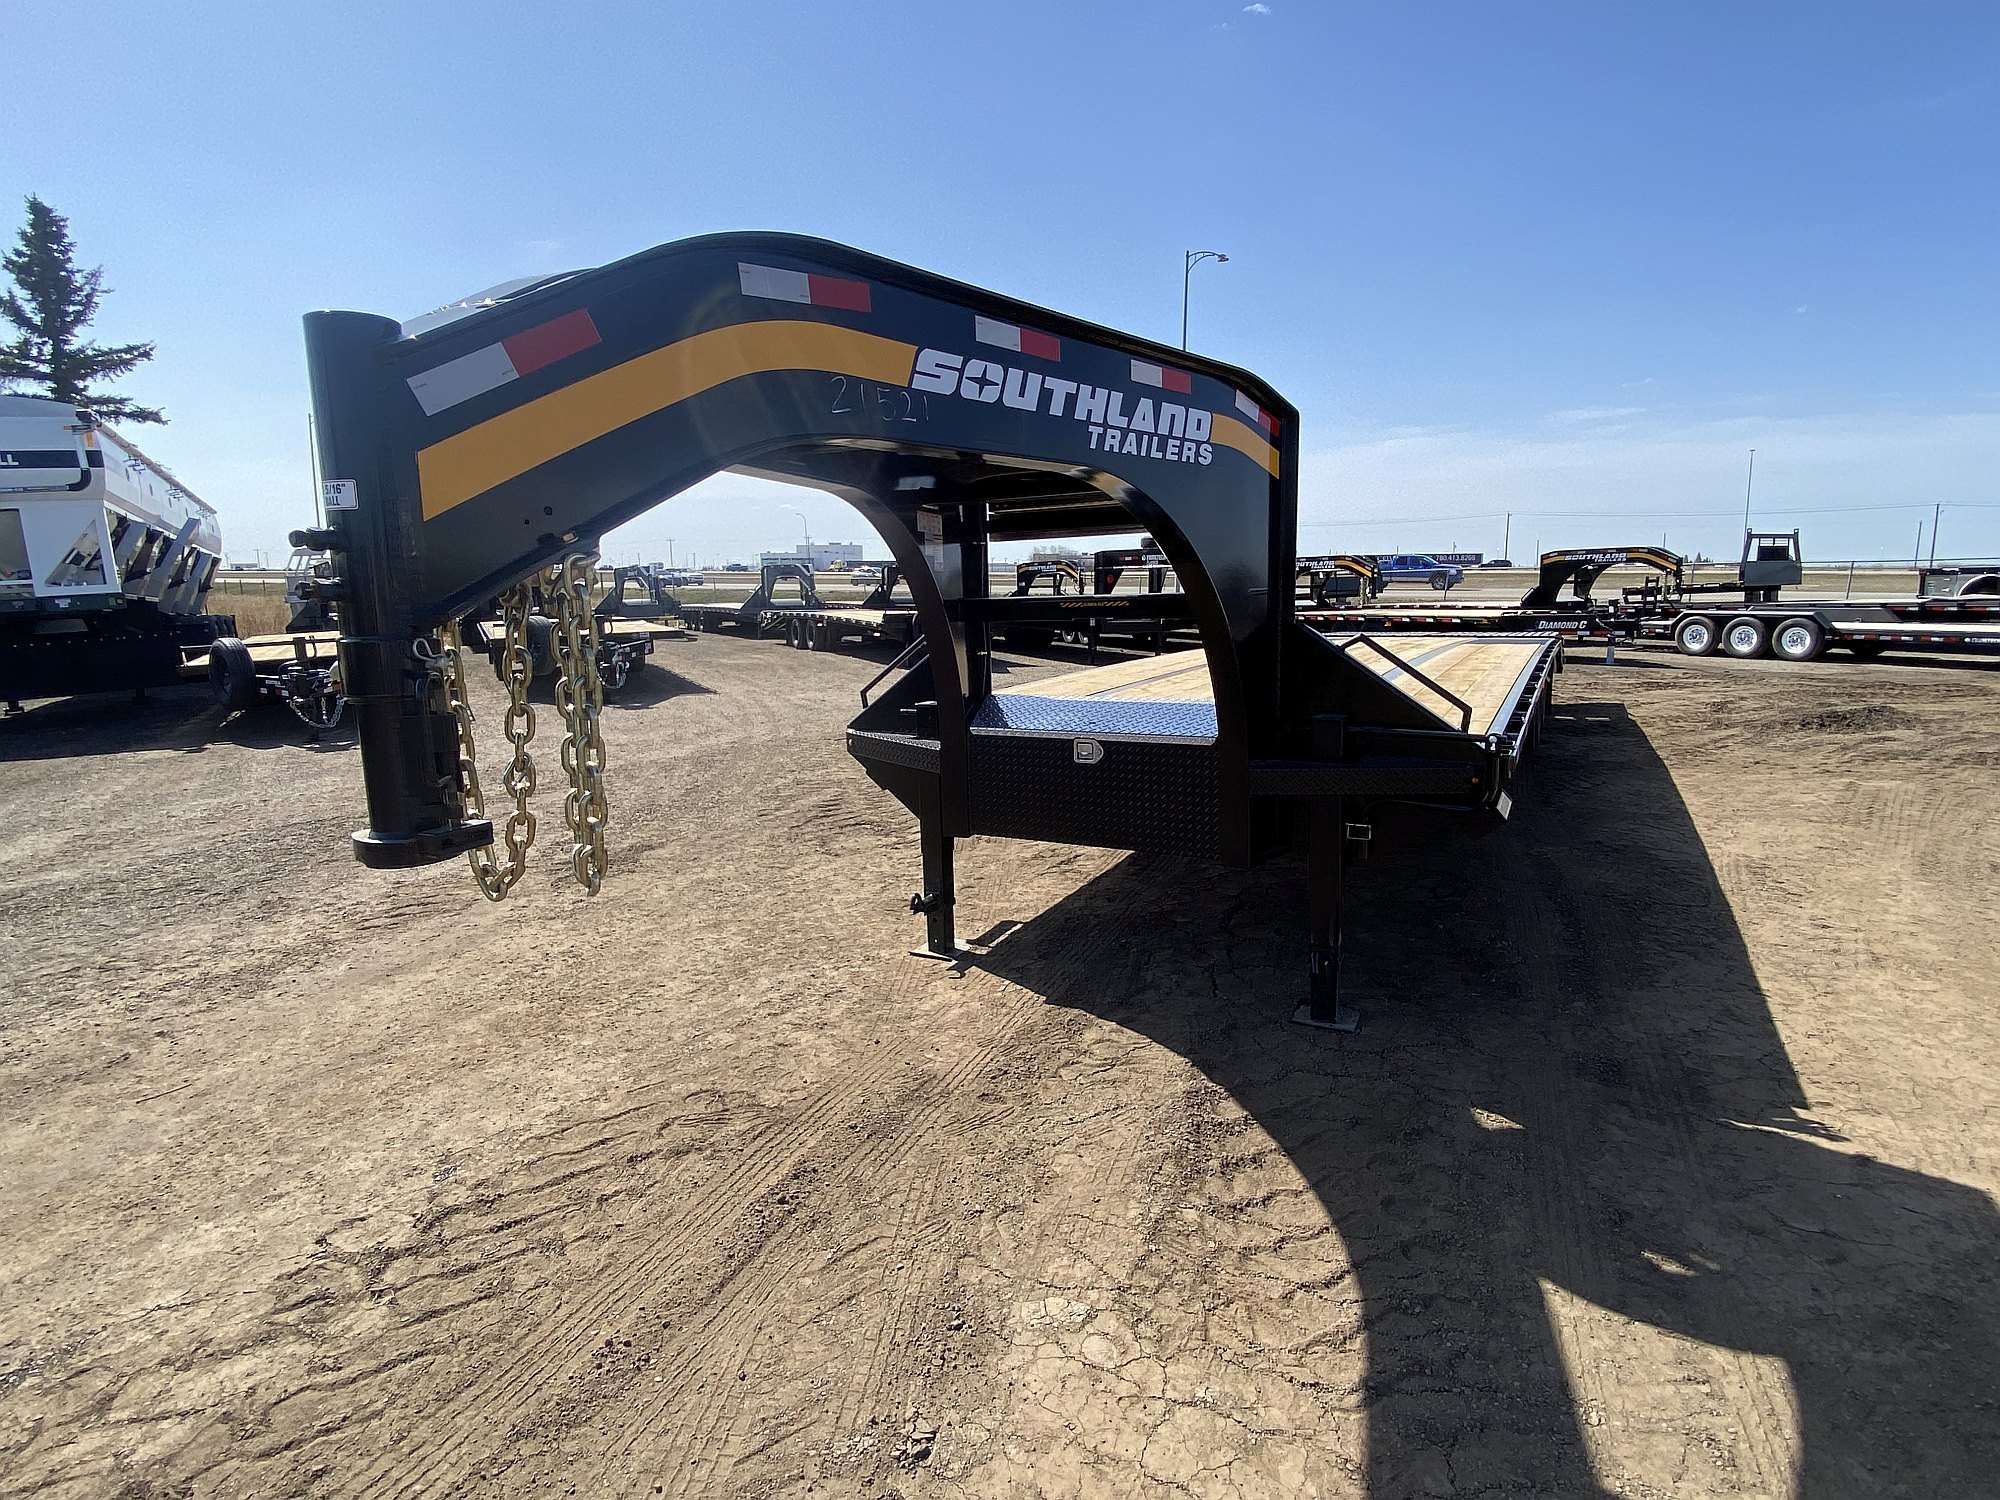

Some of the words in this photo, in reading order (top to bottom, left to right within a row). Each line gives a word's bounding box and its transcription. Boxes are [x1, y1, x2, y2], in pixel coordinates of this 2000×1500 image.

[831, 375, 928, 424] 21521
[910, 348, 1213, 442] SOUTHLAND
[1087, 425, 1214, 466] TRAILERS
[1538, 620, 1578, 629] DIAMOND
[1579, 620, 1587, 629] C
